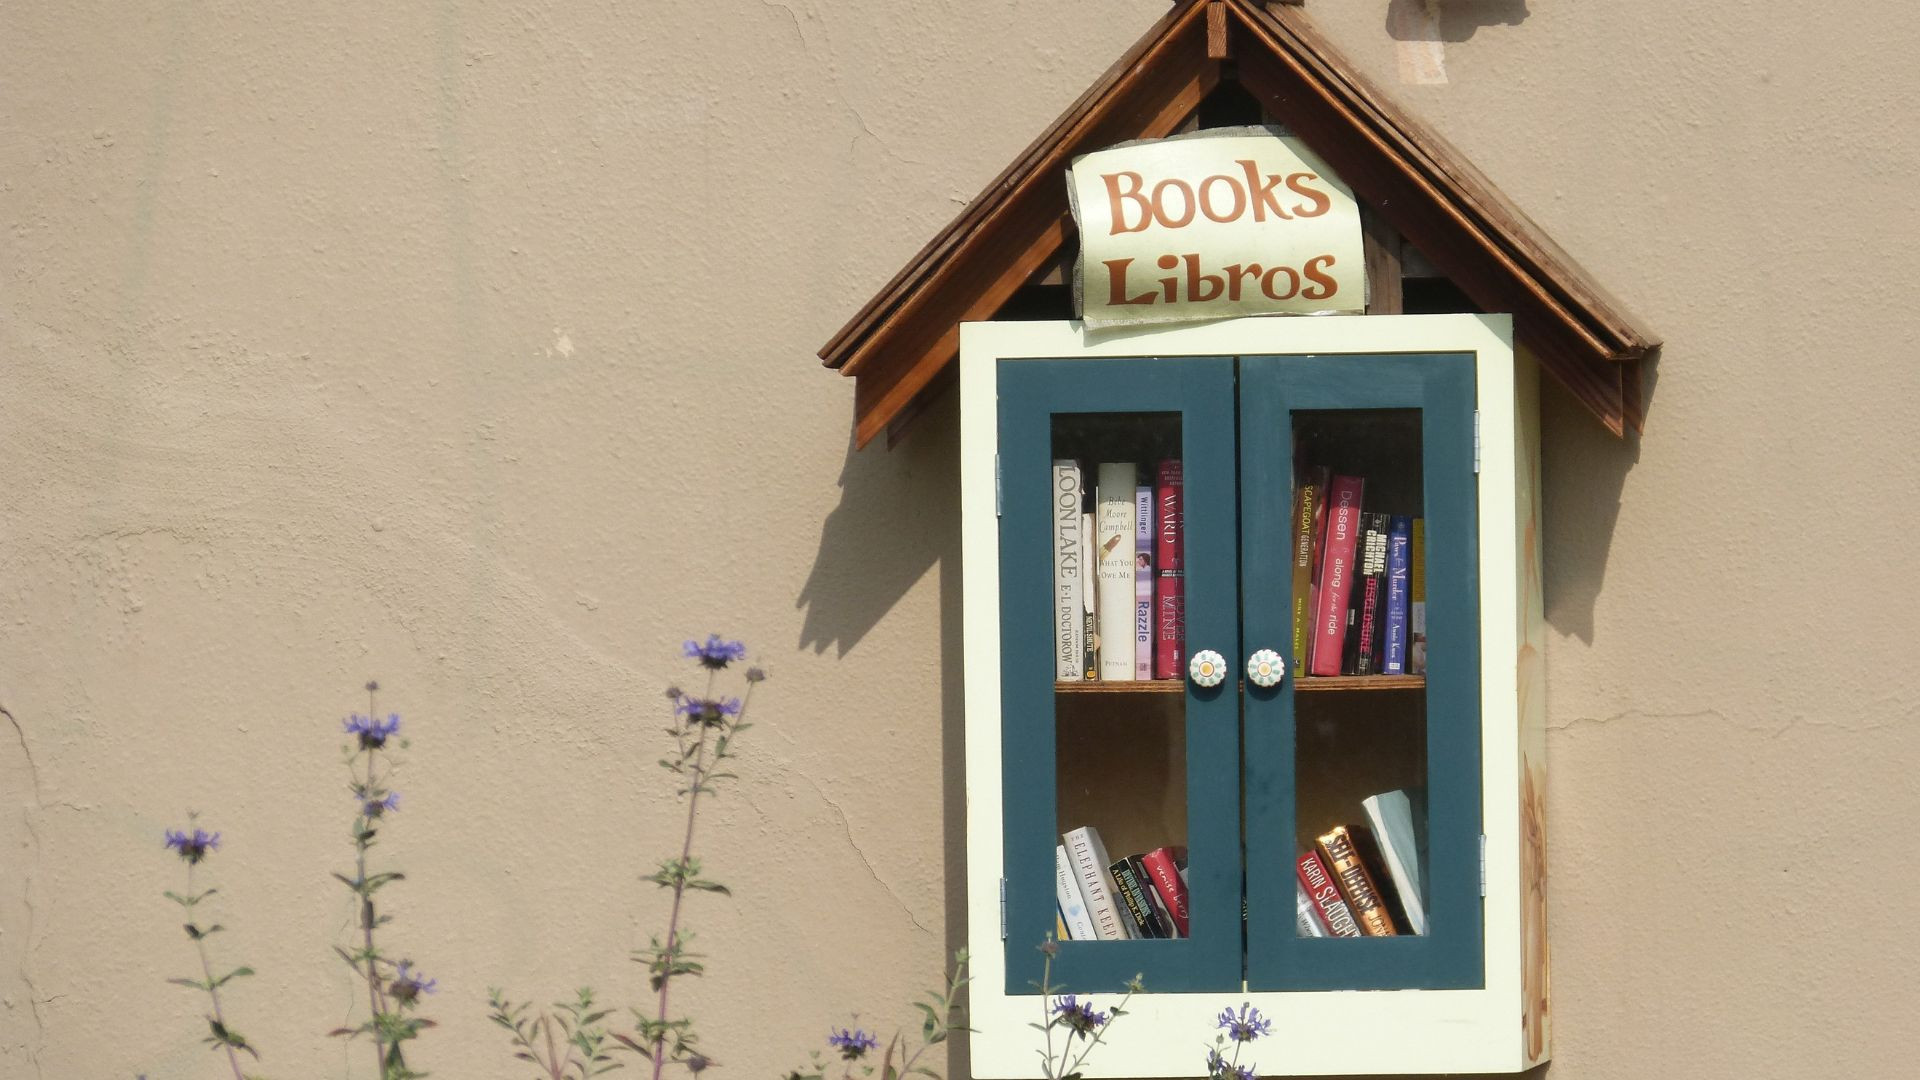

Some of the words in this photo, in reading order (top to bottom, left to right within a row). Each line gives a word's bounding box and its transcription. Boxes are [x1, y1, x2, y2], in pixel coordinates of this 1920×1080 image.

[1100, 160, 1331, 236] Books
[1101, 253, 1338, 306] Libros
[1059, 466, 1077, 522] LOON
[1106, 509, 1127, 518] Moore
[1139, 496, 1148, 534] Wittlinger
[1302, 485, 1313, 535] SCAPEGOAT
[1336, 490, 1353, 541] Dessen
[1100, 520, 1133, 534] Campbell
[1163, 495, 1176, 543] WARD
[1060, 524, 1078, 578] LAKE
[1299, 535, 1310, 567] GENERATION
[1332, 558, 1344, 588] along
[1363, 529, 1377, 576] CRICHTON
[1373, 533, 1387, 573] MICHAEL
[1392, 567, 1406, 601] Murder
[1061, 606, 1074, 664] DOCTOROW
[1086, 615, 1094, 632] NEVIL
[1138, 601, 1149, 642] Razzle
[1163, 594, 1176, 640] MINE
[1328, 614, 1338, 635] ride
[1360, 578, 1377, 654] DISCLOSURE
[1074, 842, 1105, 902] ELEPHANT
[1156, 865, 1175, 893] venise
[1173, 893, 1189, 919] berry
[1301, 857, 1326, 889] KARIN
[1134, 911, 1145, 926] Dick
